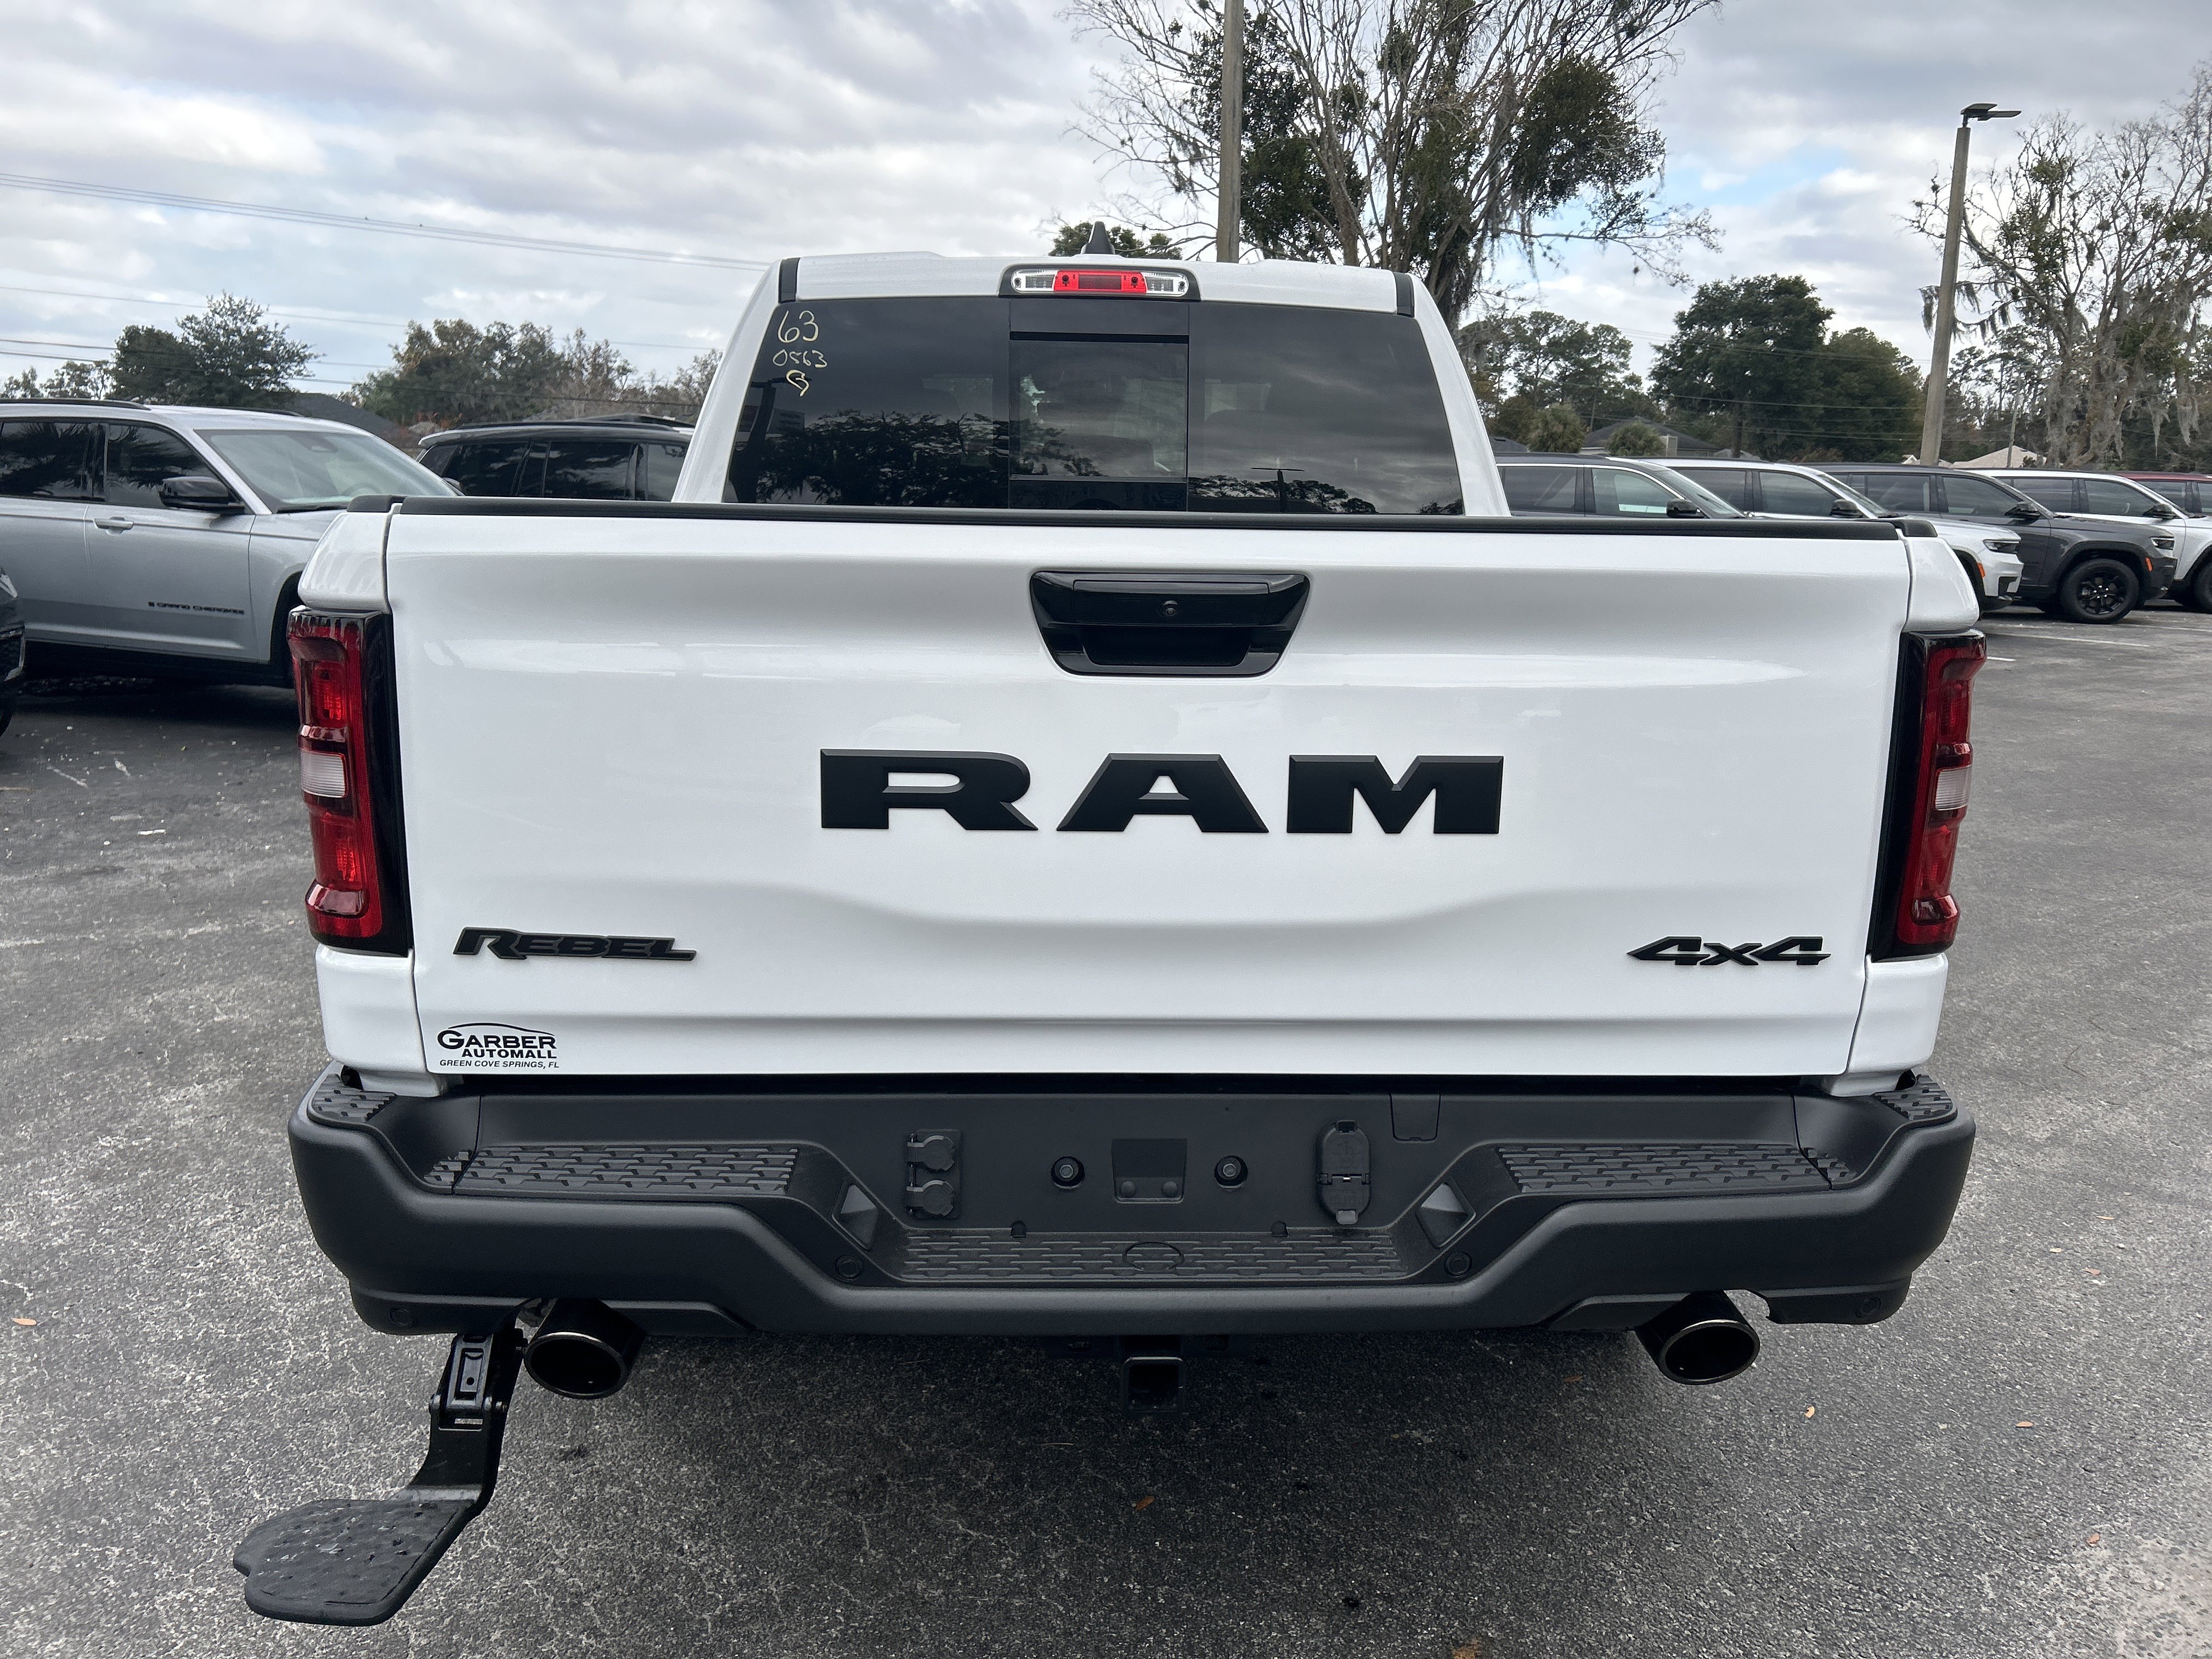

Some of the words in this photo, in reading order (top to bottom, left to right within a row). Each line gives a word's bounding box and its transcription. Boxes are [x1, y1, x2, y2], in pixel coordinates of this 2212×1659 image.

[777, 310, 819, 343] 63
[772, 349, 827, 368] 0563
[821, 749, 1504, 834] RAM
[453, 927, 697, 961] REBEL
[438, 1030, 556, 1049] GARBER
[461, 1049, 557, 1058] AUTOMALL
[503, 1060, 546, 1069] SPRINGS,
